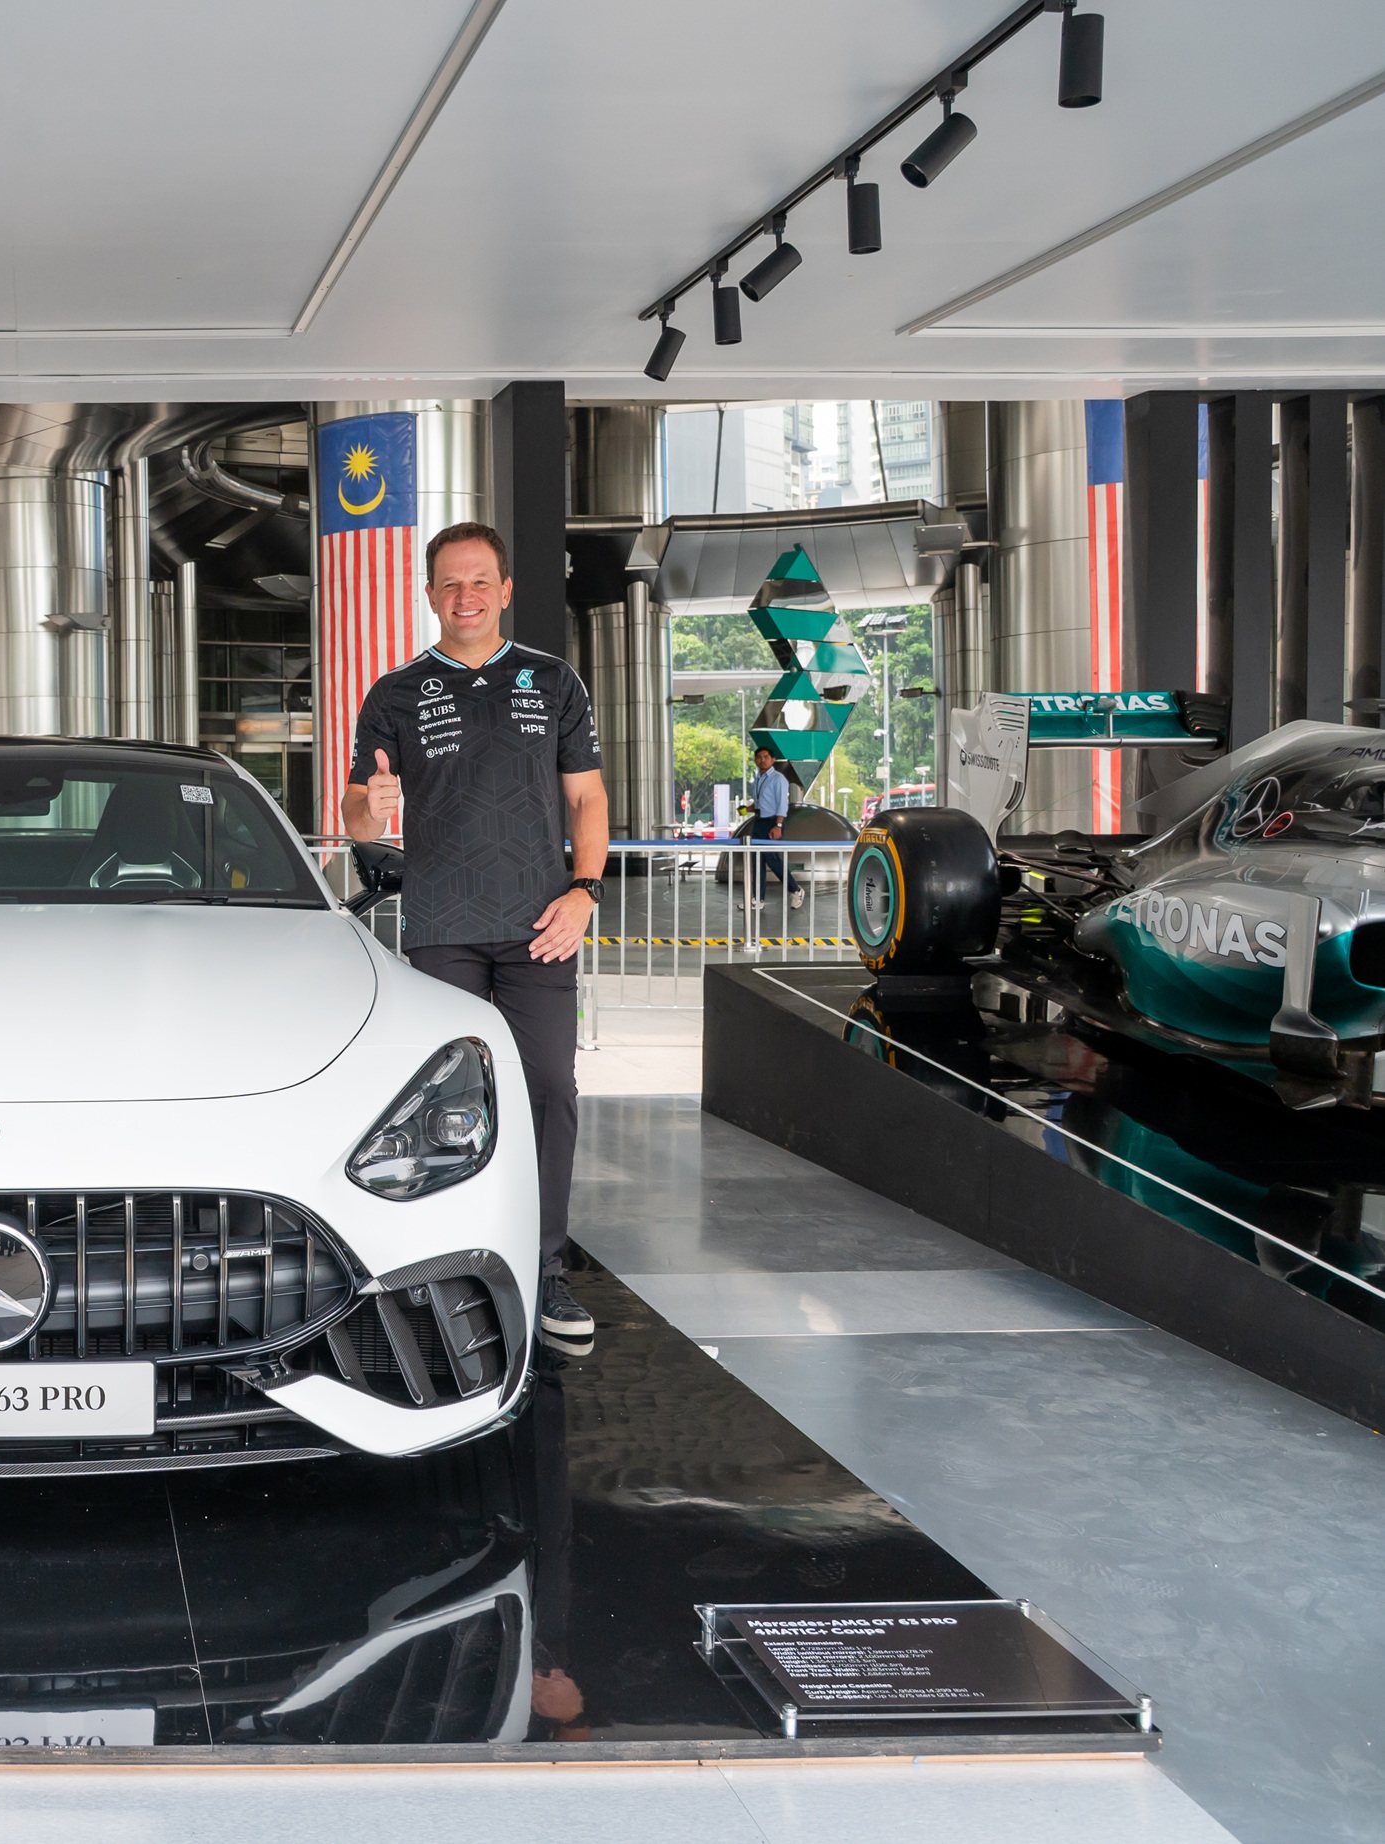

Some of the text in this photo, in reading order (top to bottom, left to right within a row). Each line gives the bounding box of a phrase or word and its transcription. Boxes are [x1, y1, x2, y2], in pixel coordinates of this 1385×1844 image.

[432, 703, 456, 717] UBS
[510, 698, 545, 710] INEOS
[518, 712, 549, 720] TeamViewer
[421, 716, 462, 731] CROWDSTRIKE
[520, 723, 546, 735] HPE
[429, 730, 463, 740] Snapdragon
[39, 1384, 106, 1411] PRO
[747, 1619, 870, 1628] Mercedes-AMG
[898, 1618, 919, 1626] 63
[920, 1617, 957, 1626] PRO
[754, 1628, 885, 1636] 4MATIC+ Coupe
